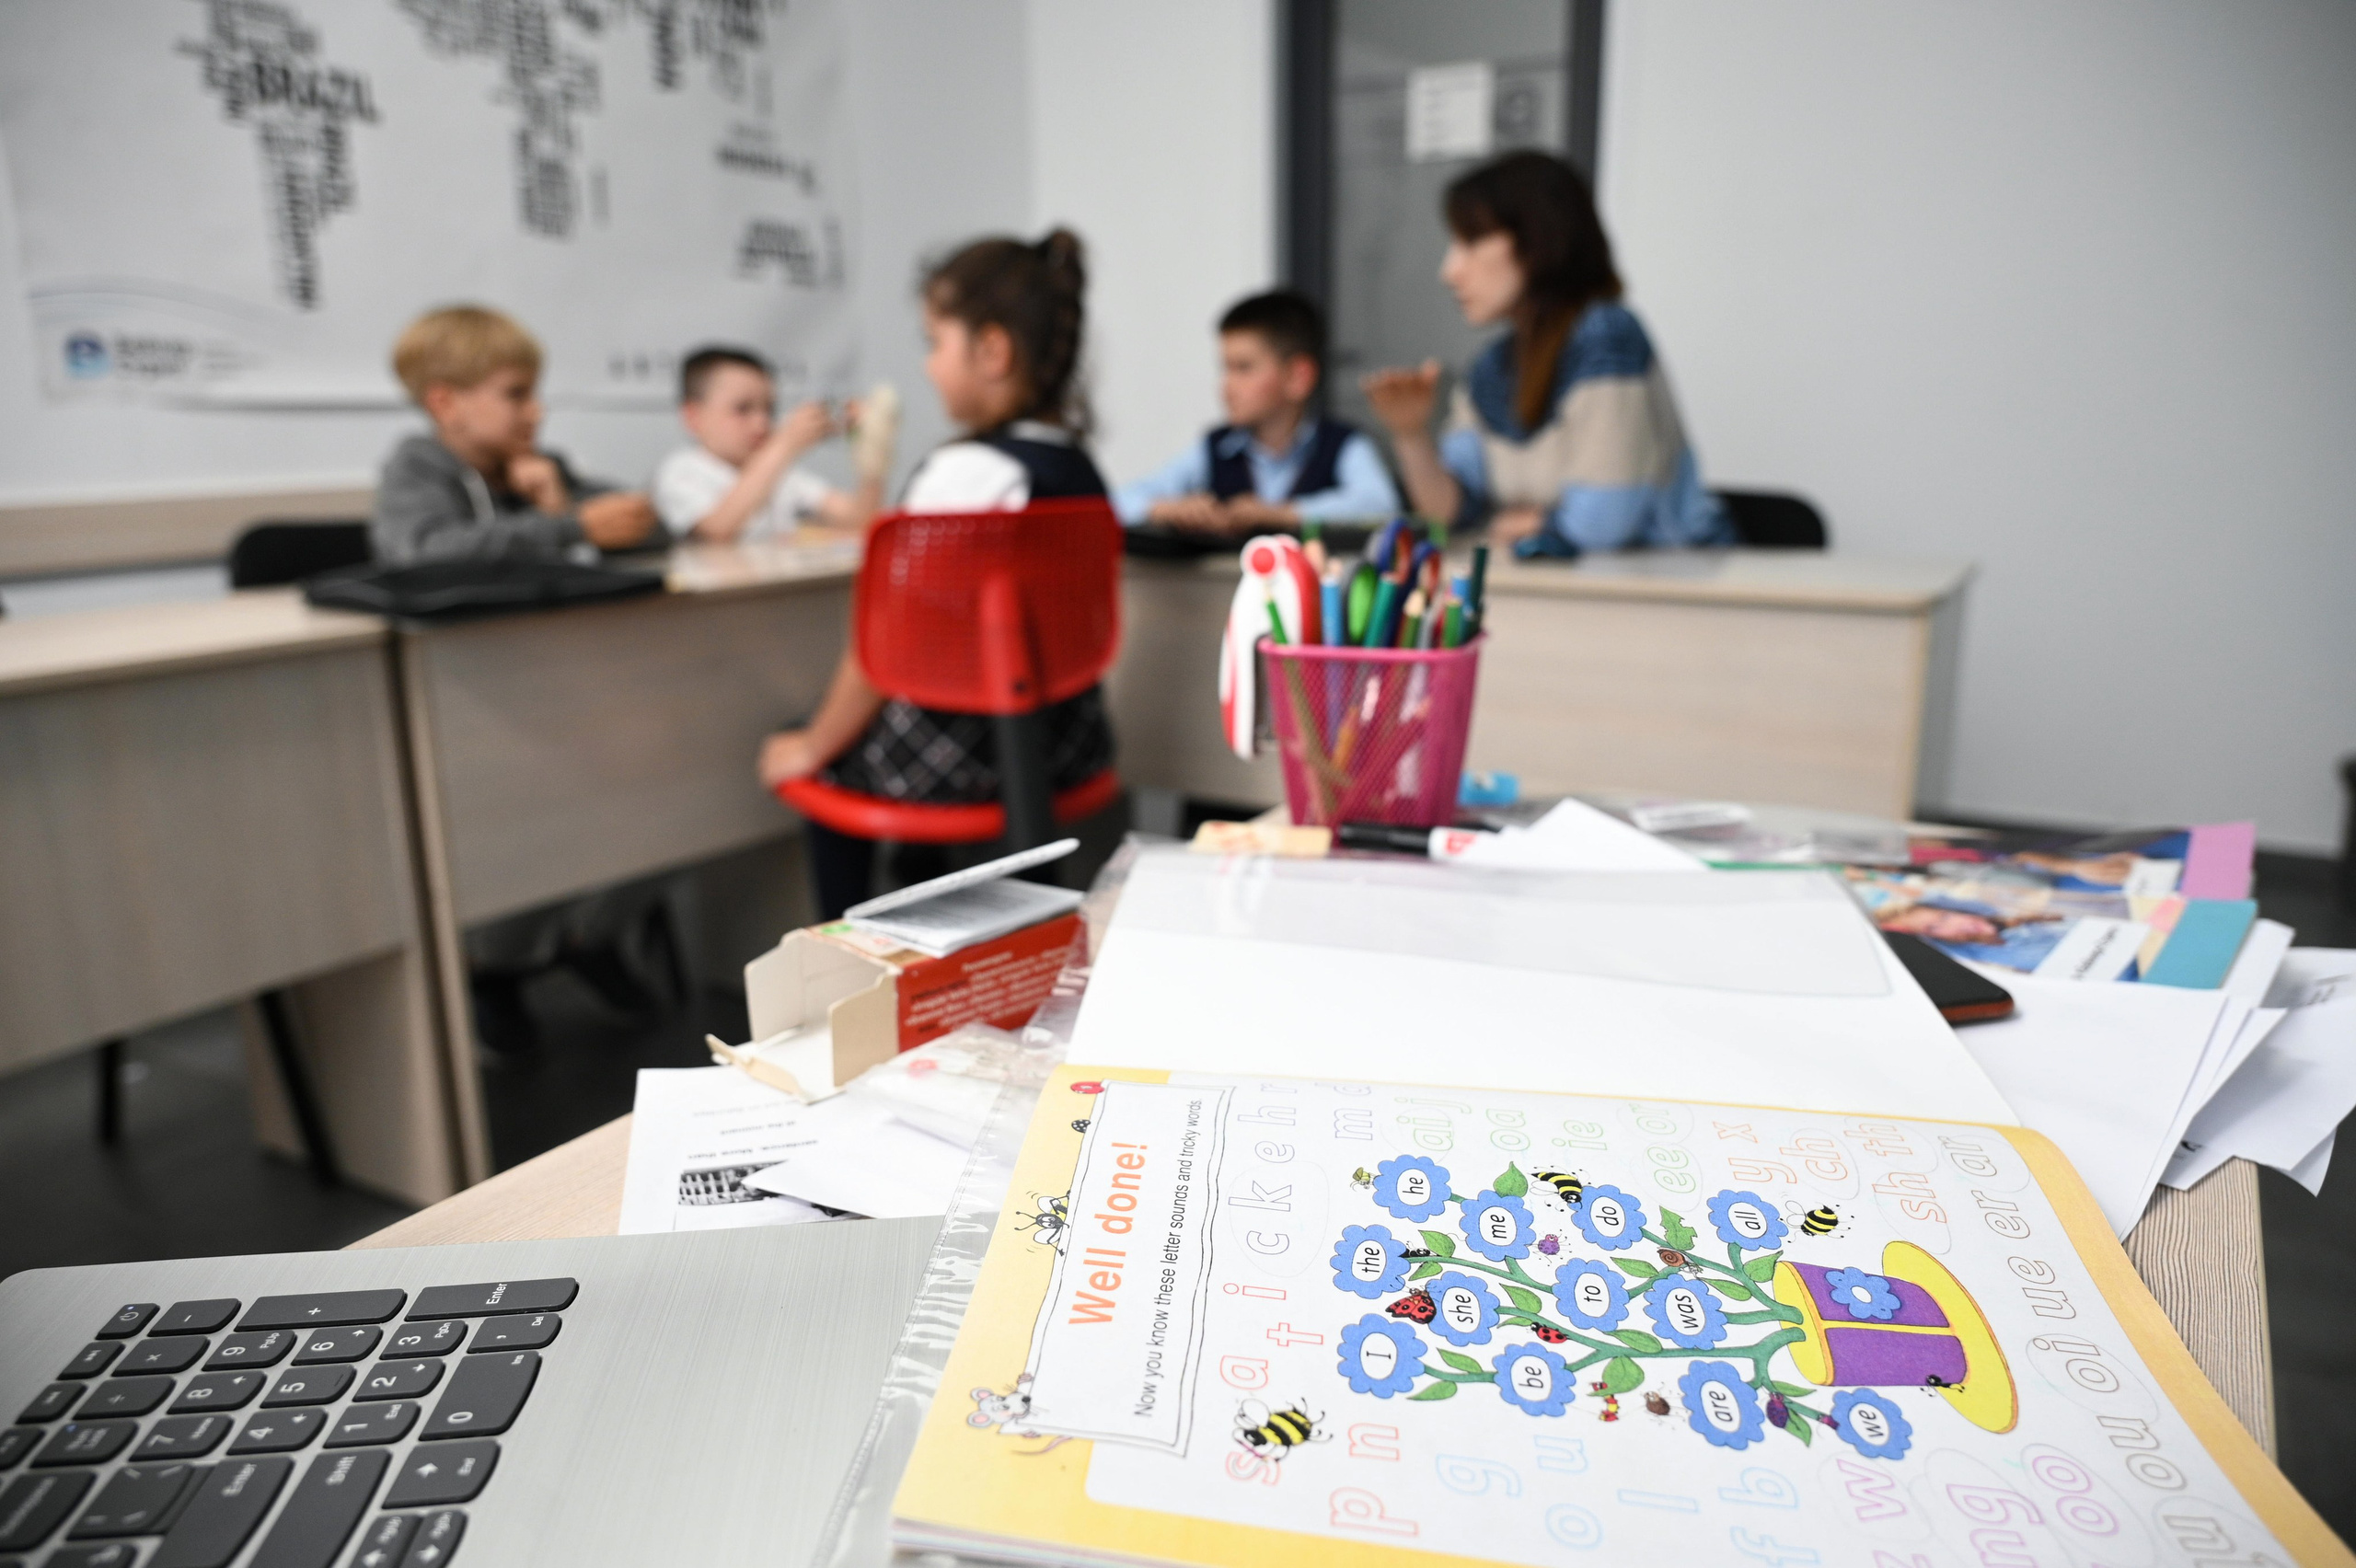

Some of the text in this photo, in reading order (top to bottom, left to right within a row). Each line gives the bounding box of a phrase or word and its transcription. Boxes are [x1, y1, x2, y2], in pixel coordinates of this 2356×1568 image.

[1237, 1105, 1297, 1126] h
[1334, 1107, 1374, 1141] m
[1485, 1108, 1531, 1152] oa
[1179, 1128, 1202, 1158] tricky
[1395, 1115, 1454, 1152] ai
[1552, 1119, 1609, 1152] ie
[1714, 1121, 1759, 1144] x
[1842, 1118, 1913, 1158] th
[1254, 1140, 1296, 1164] e
[1779, 1136, 1850, 1182] ch
[1937, 1135, 1997, 1178] ar
[1176, 1159, 1193, 1182] and
[1646, 1146, 1697, 1194] ee
[1727, 1157, 1798, 1185] y
[1402, 1175, 1425, 1196] he
[1872, 1171, 1948, 1225] sh
[1170, 1184, 1189, 1229] sounds
[1595, 1205, 1622, 1228] do
[1734, 1210, 1761, 1230] all
[1970, 1189, 2031, 1239] er
[1068, 1141, 1149, 1325] Well done!
[1489, 1213, 1508, 1240] me
[1160, 1231, 1182, 1264] letter
[1361, 1246, 1381, 1274] the
[484, 1283, 507, 1305] Enter
[1153, 1268, 1176, 1306] these
[1583, 1284, 1601, 1305] to
[2007, 1255, 2077, 1320] ue
[531, 1316, 545, 1328] Del
[1452, 1293, 1474, 1325] she
[1678, 1293, 1701, 1331] was
[260, 1332, 280, 1350] PgUp
[398, 1334, 422, 1348] 3
[434, 1321, 452, 1340] PgDn
[1145, 1309, 1169, 1346] know
[1266, 1321, 1324, 1348] t
[221, 1345, 247, 1357] 9
[310, 1339, 336, 1353] 6
[511, 1353, 525, 1366] Ins
[1366, 1350, 1392, 1362] I
[1145, 1350, 1165, 1378] you
[1220, 1355, 1269, 1390] a
[1518, 1366, 1545, 1390] be
[2032, 1336, 2120, 1393] oi
[186, 1388, 214, 1400] 8
[279, 1380, 306, 1394] 5
[370, 1375, 398, 1389] 2
[385, 1402, 403, 1421] End
[1134, 1381, 1157, 1417] Now
[1711, 1389, 1734, 1424] are
[249, 1426, 275, 1440] 4
[342, 1423, 369, 1433] 1
[1865, 1409, 1887, 1439] we
[148, 1434, 175, 1448] 7
[1347, 1422, 1401, 1462] n
[222, 1462, 258, 1496] Enter
[325, 1454, 357, 1486] Shift
[1435, 1453, 1523, 1500] g
[1717, 1466, 1800, 1510] b
[1835, 1458, 1908, 1523] w
[2031, 1454, 2120, 1538] oo
[1329, 1486, 1420, 1538] p
